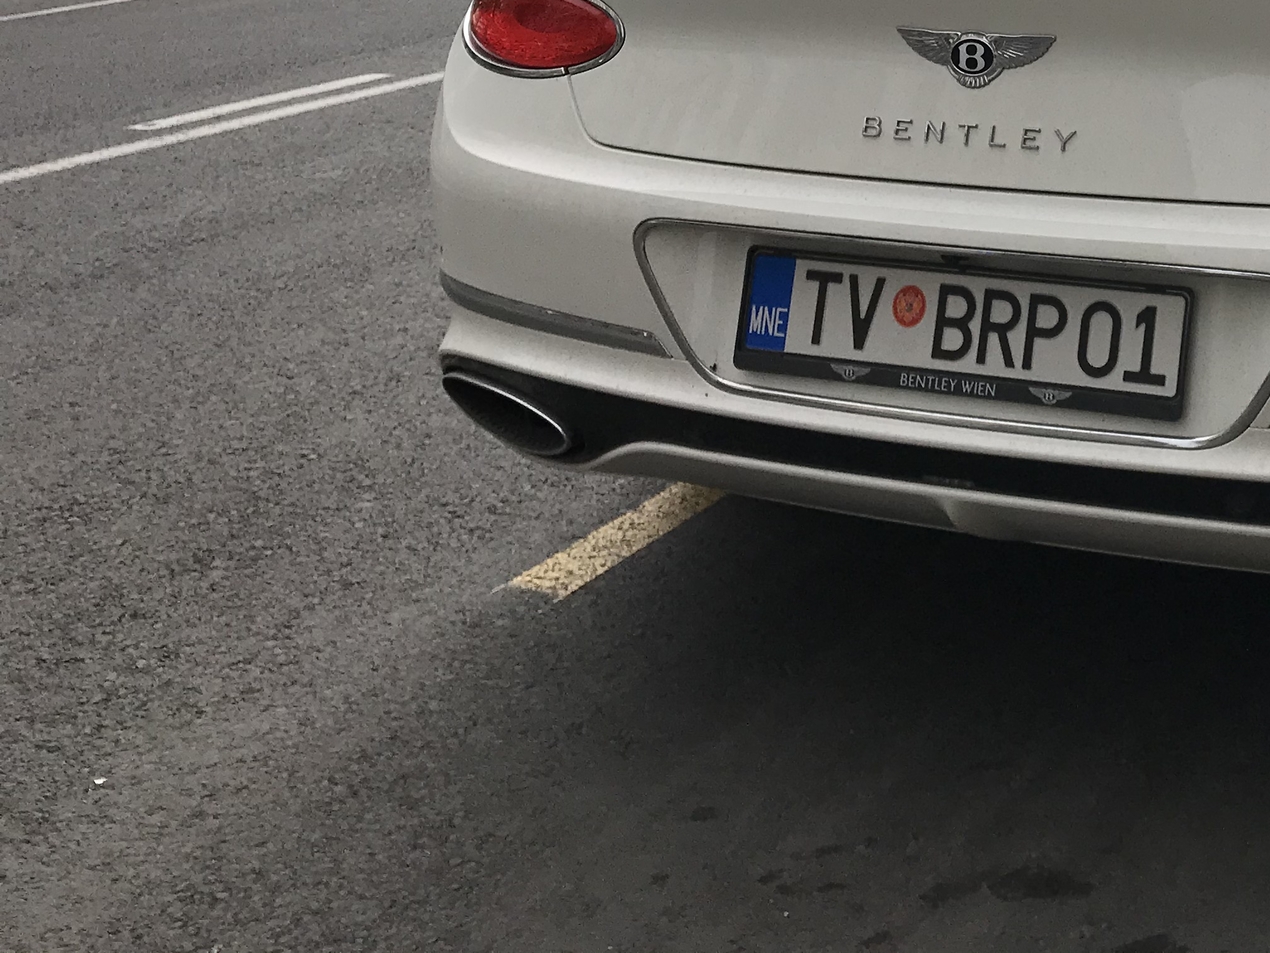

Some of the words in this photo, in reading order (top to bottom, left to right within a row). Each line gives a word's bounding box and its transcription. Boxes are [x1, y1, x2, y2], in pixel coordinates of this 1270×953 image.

[957, 42, 986, 72] B
[862, 115, 1077, 152] BENTLEY
[749, 304, 788, 338] MNE
[805, 269, 887, 351] TV
[899, 372, 958, 392] BENTLEY
[961, 379, 997, 397] WIEN
